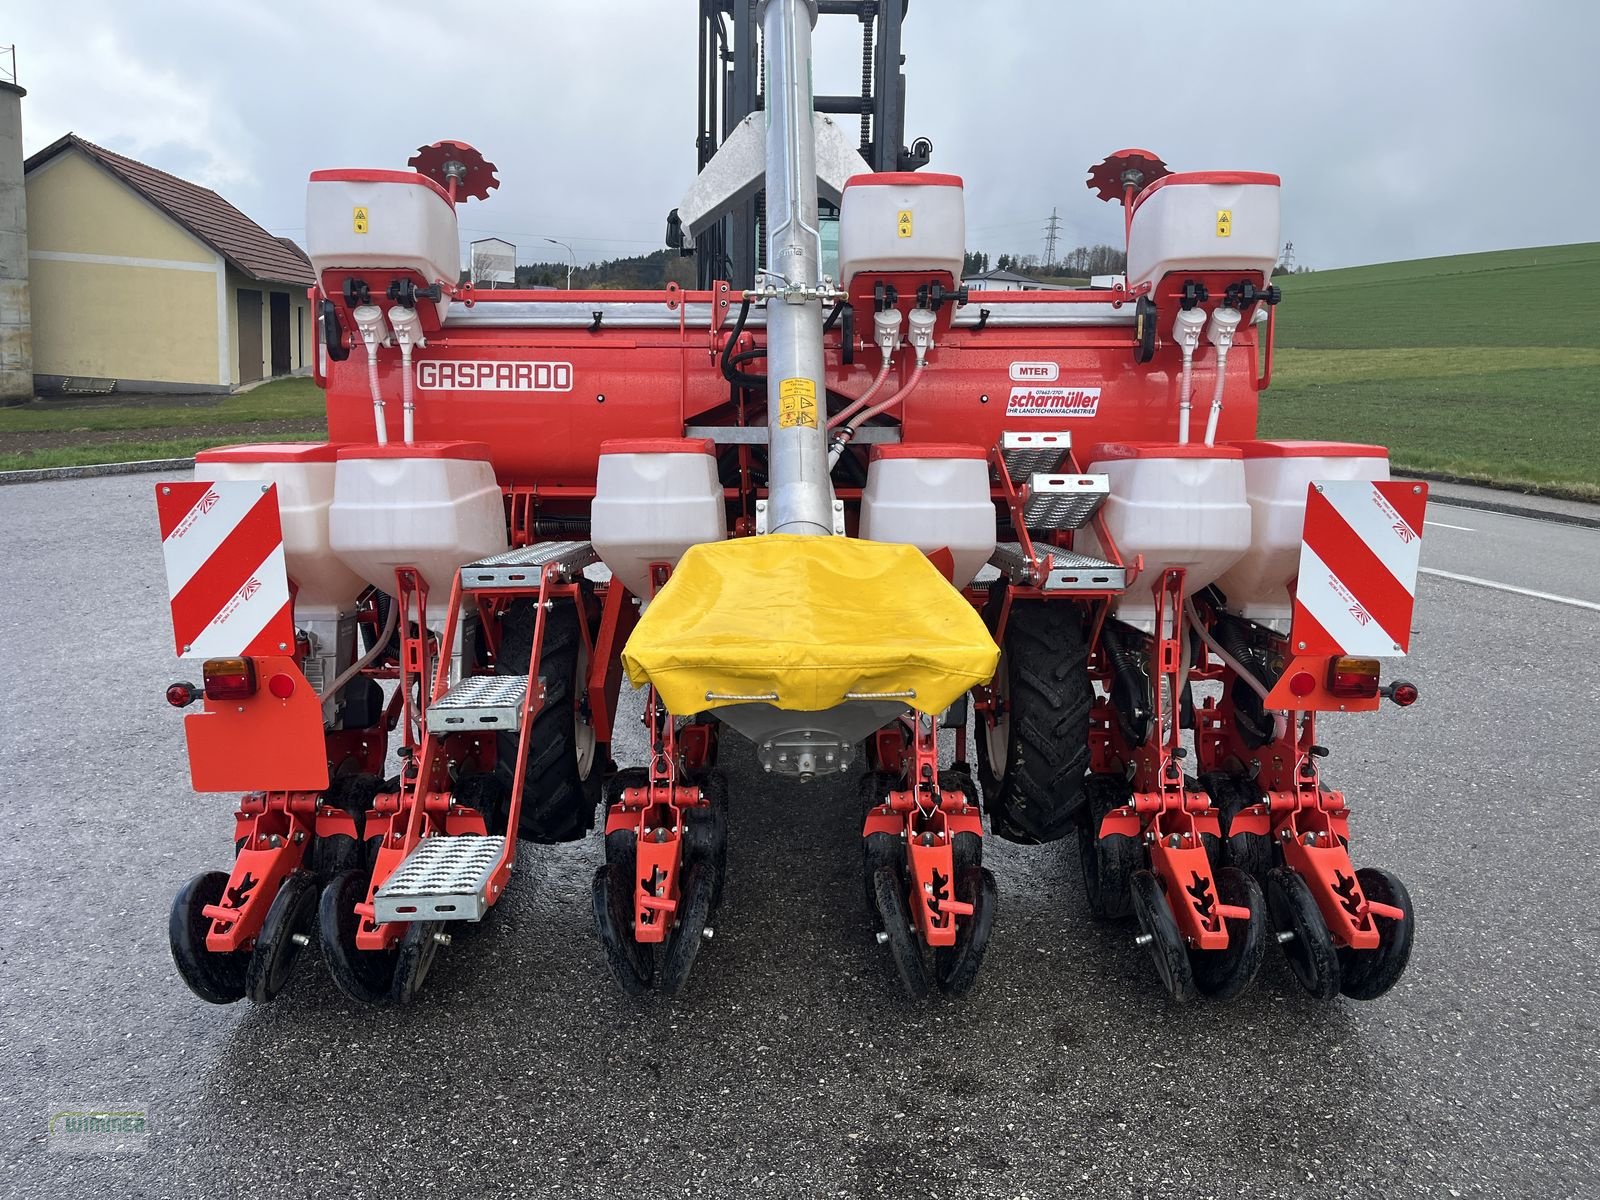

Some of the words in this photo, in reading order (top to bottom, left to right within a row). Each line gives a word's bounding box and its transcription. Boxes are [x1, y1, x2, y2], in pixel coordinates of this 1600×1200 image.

[419, 363, 571, 389] GASPARDO
[1019, 367, 1049, 376] MTER
[1009, 391, 1099, 408] scharmüller
